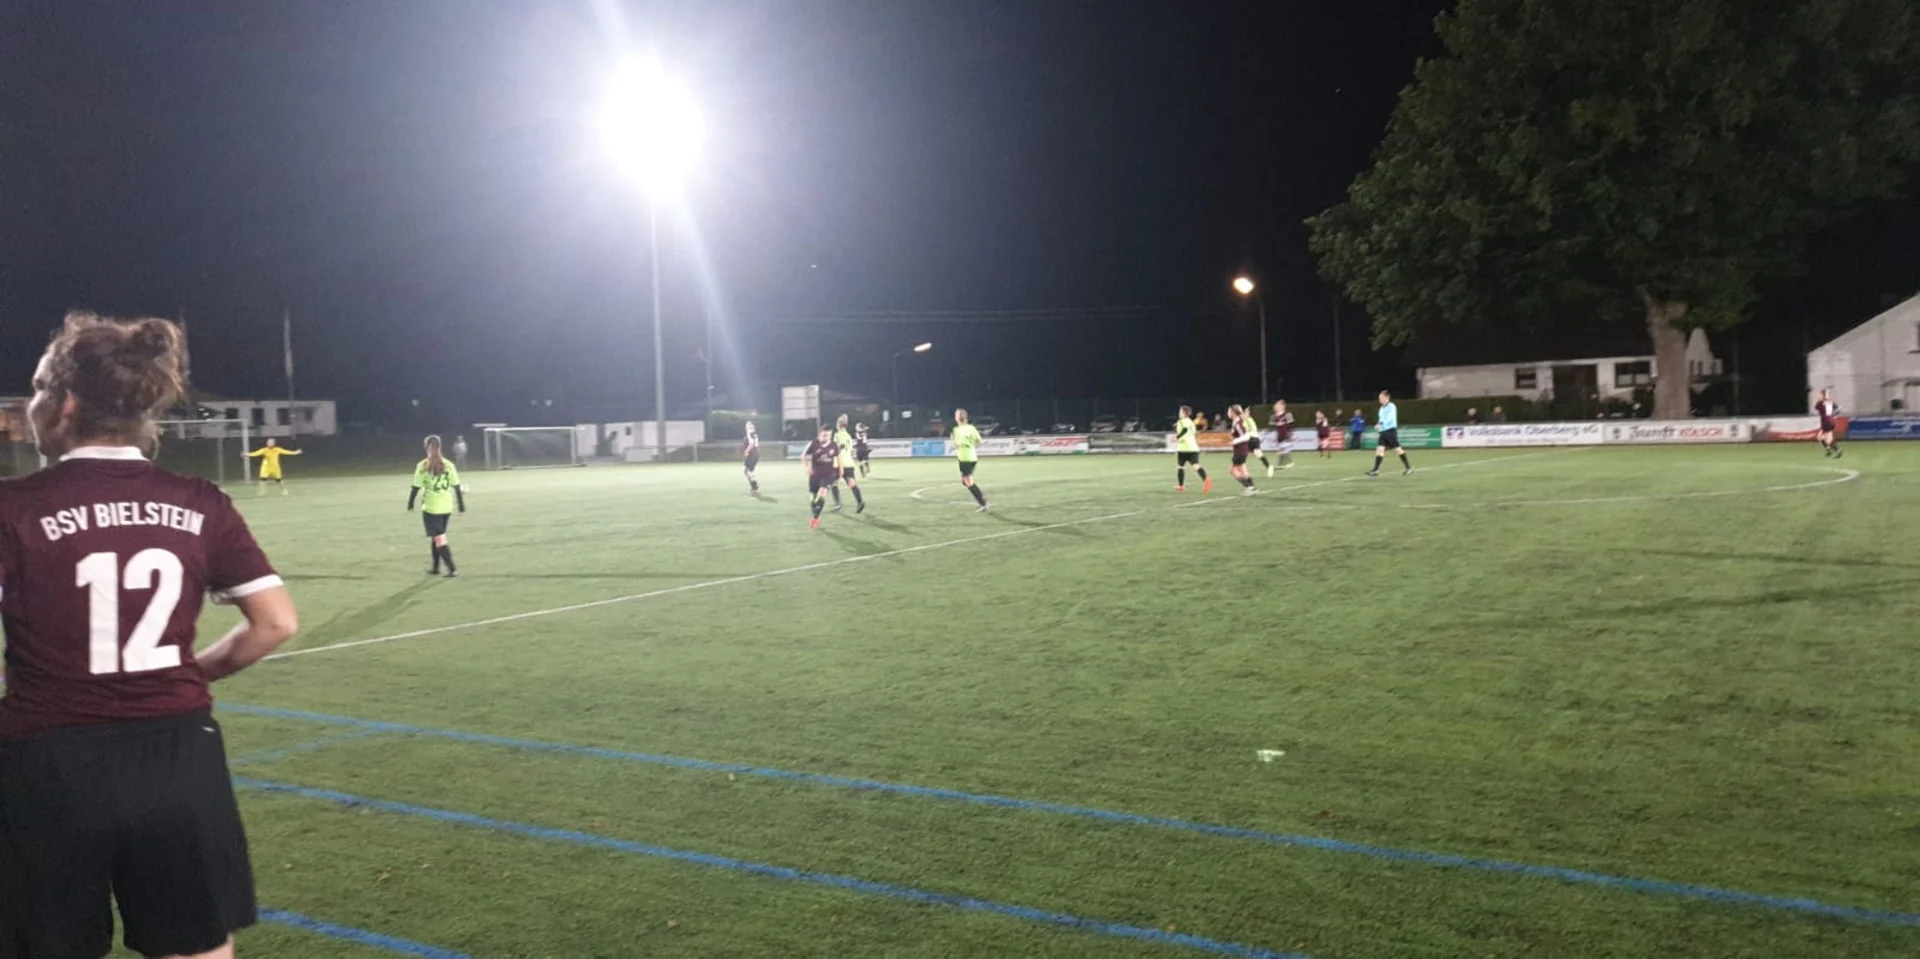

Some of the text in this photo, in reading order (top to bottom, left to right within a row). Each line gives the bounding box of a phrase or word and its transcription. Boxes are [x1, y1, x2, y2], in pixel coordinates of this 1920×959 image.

[1469, 426, 1522, 437] Volksbank
[1524, 425, 1580, 437] Oberberg
[432, 472, 450, 492] 23
[40, 501, 205, 542] BSV BIELSTEIN
[75, 548, 184, 675] 12
